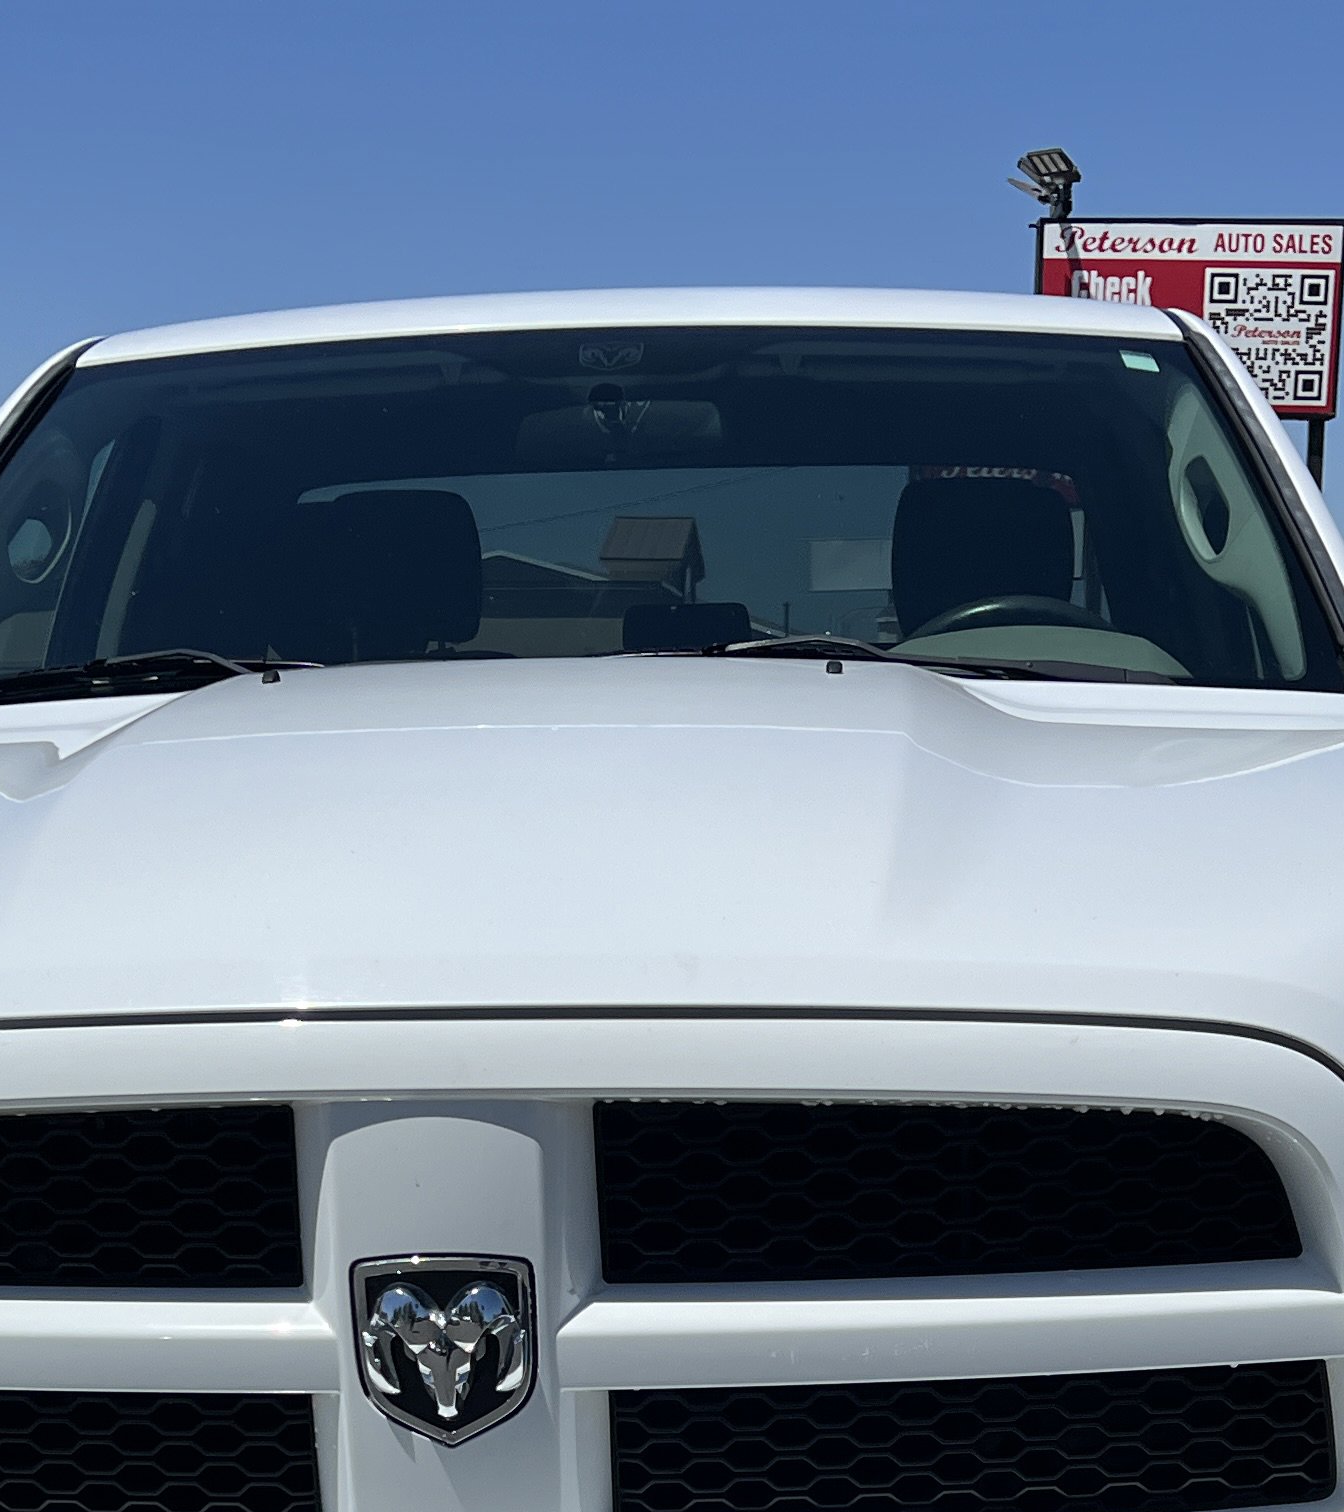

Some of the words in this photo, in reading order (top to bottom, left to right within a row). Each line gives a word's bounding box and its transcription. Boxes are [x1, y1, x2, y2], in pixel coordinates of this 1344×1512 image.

[1056, 226, 1199, 254] Peterson
[1214, 233, 1265, 253] AUTO
[1272, 233, 1333, 254] SALES
[1071, 270, 1153, 306] Check
[1231, 324, 1301, 339] Peterson
